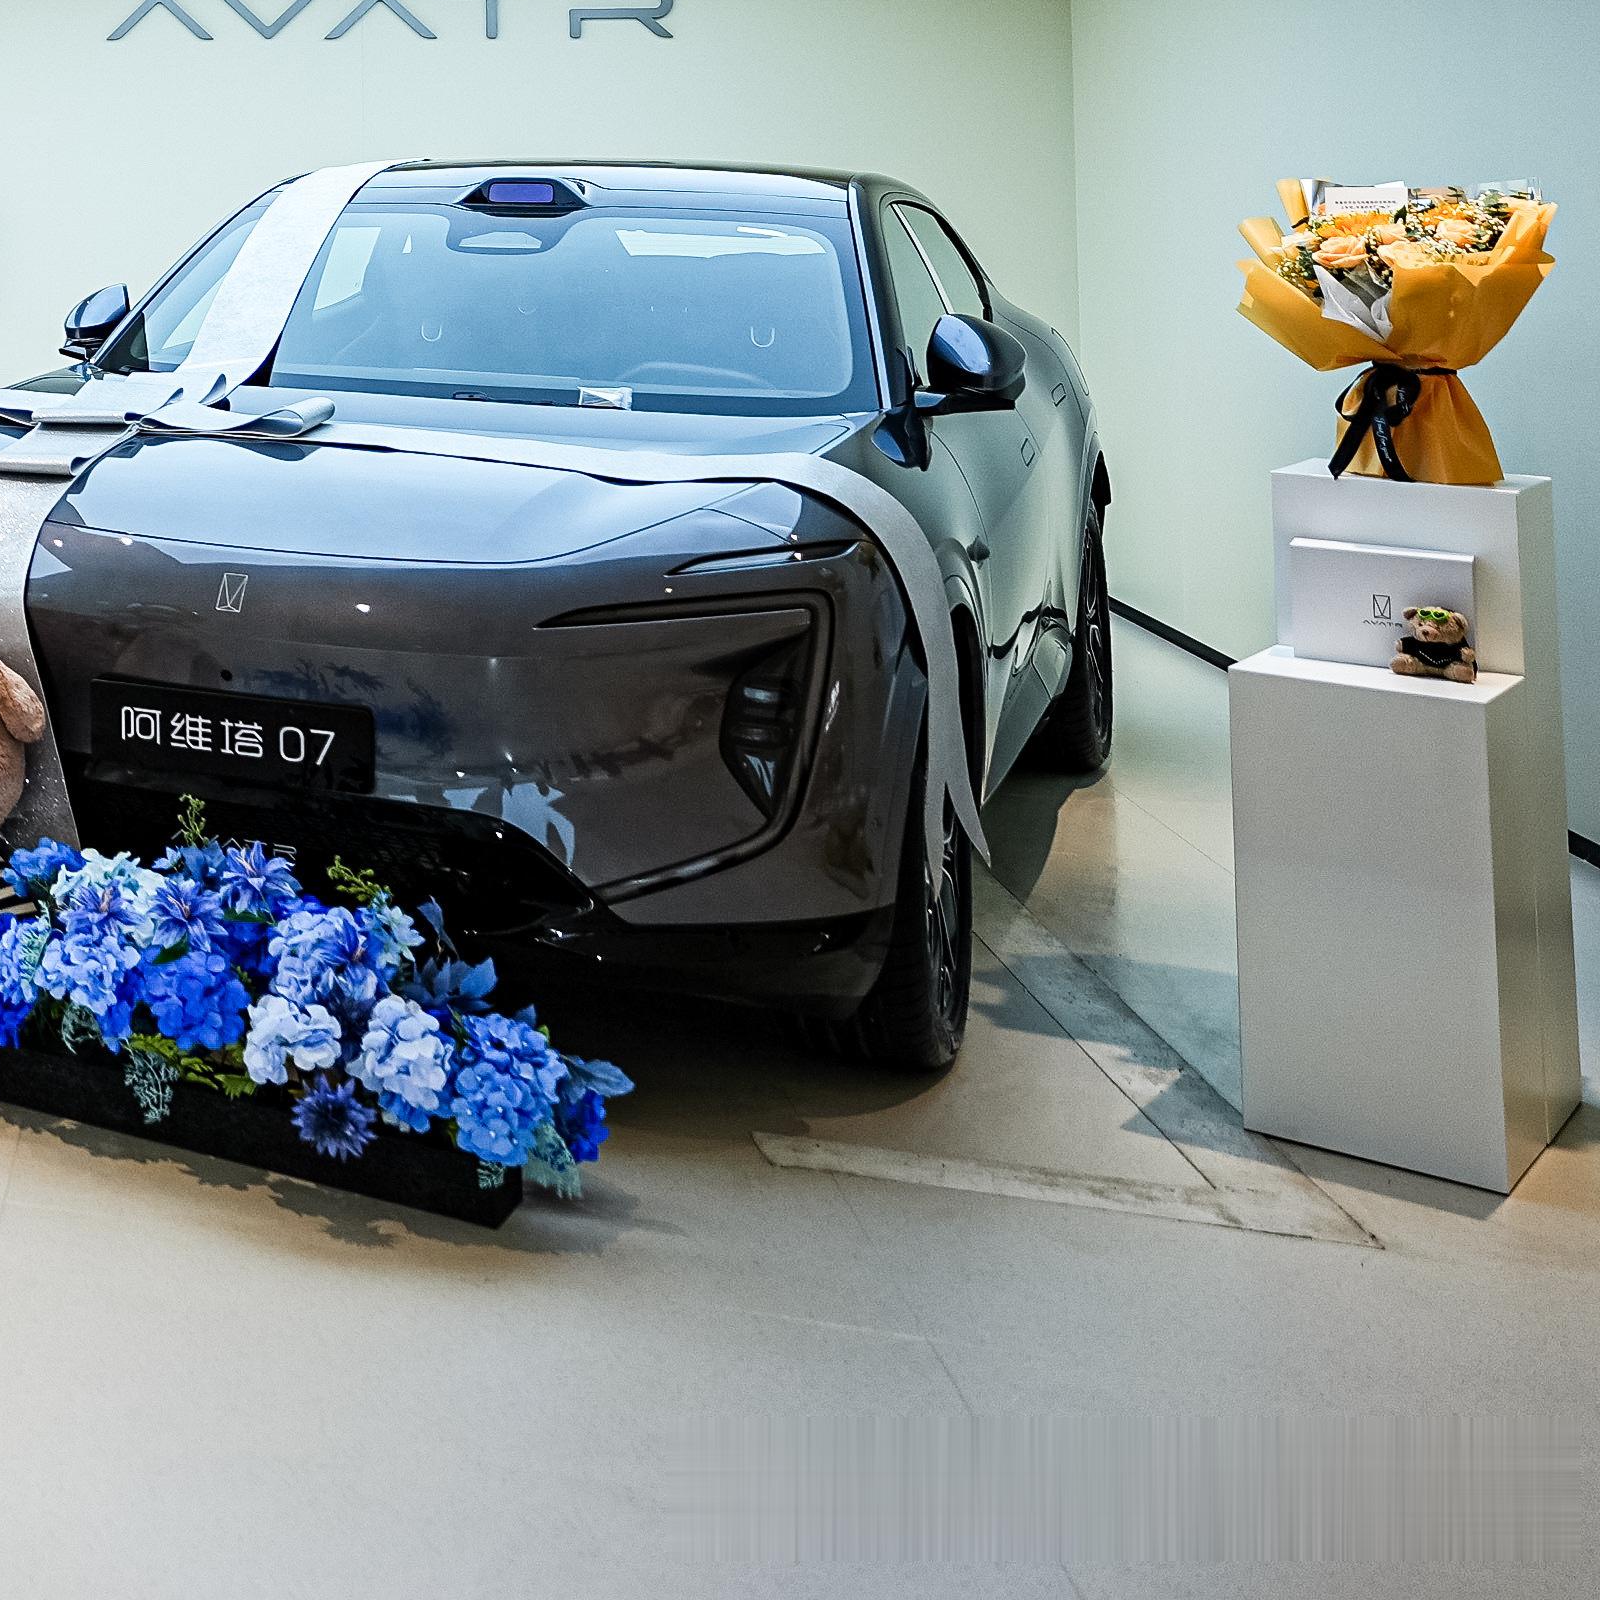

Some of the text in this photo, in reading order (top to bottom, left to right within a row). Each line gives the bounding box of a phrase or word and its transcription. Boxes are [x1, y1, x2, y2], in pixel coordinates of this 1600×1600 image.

[121, 705, 336, 766] 阿维塔 07
